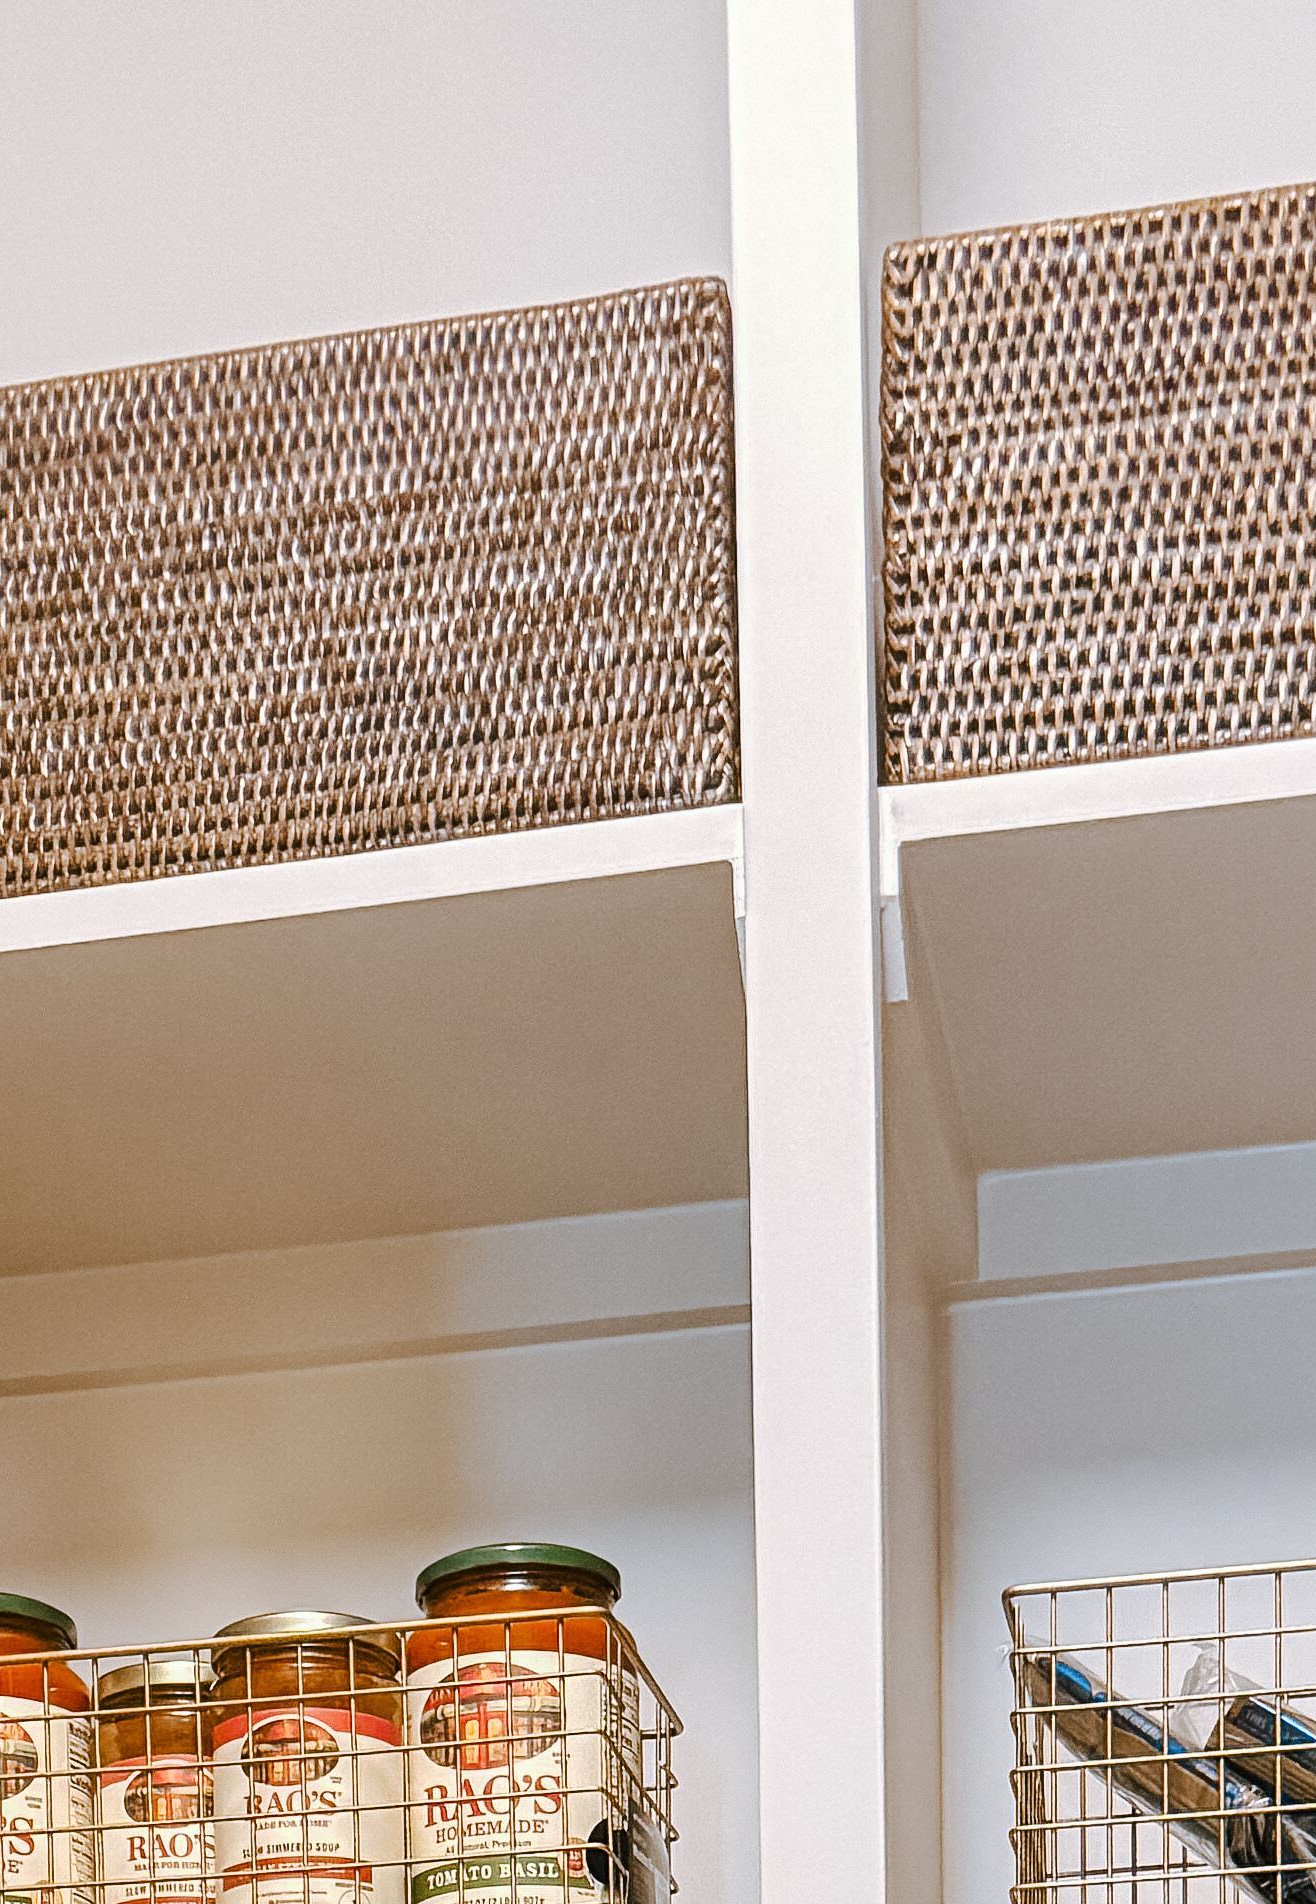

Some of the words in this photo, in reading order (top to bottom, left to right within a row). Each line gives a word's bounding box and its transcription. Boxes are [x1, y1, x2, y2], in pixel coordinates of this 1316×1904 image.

[424, 1774, 562, 1828] RAO'S
[427, 1864, 492, 1890] TOMATO
[499, 1862, 559, 1878] BASIL
